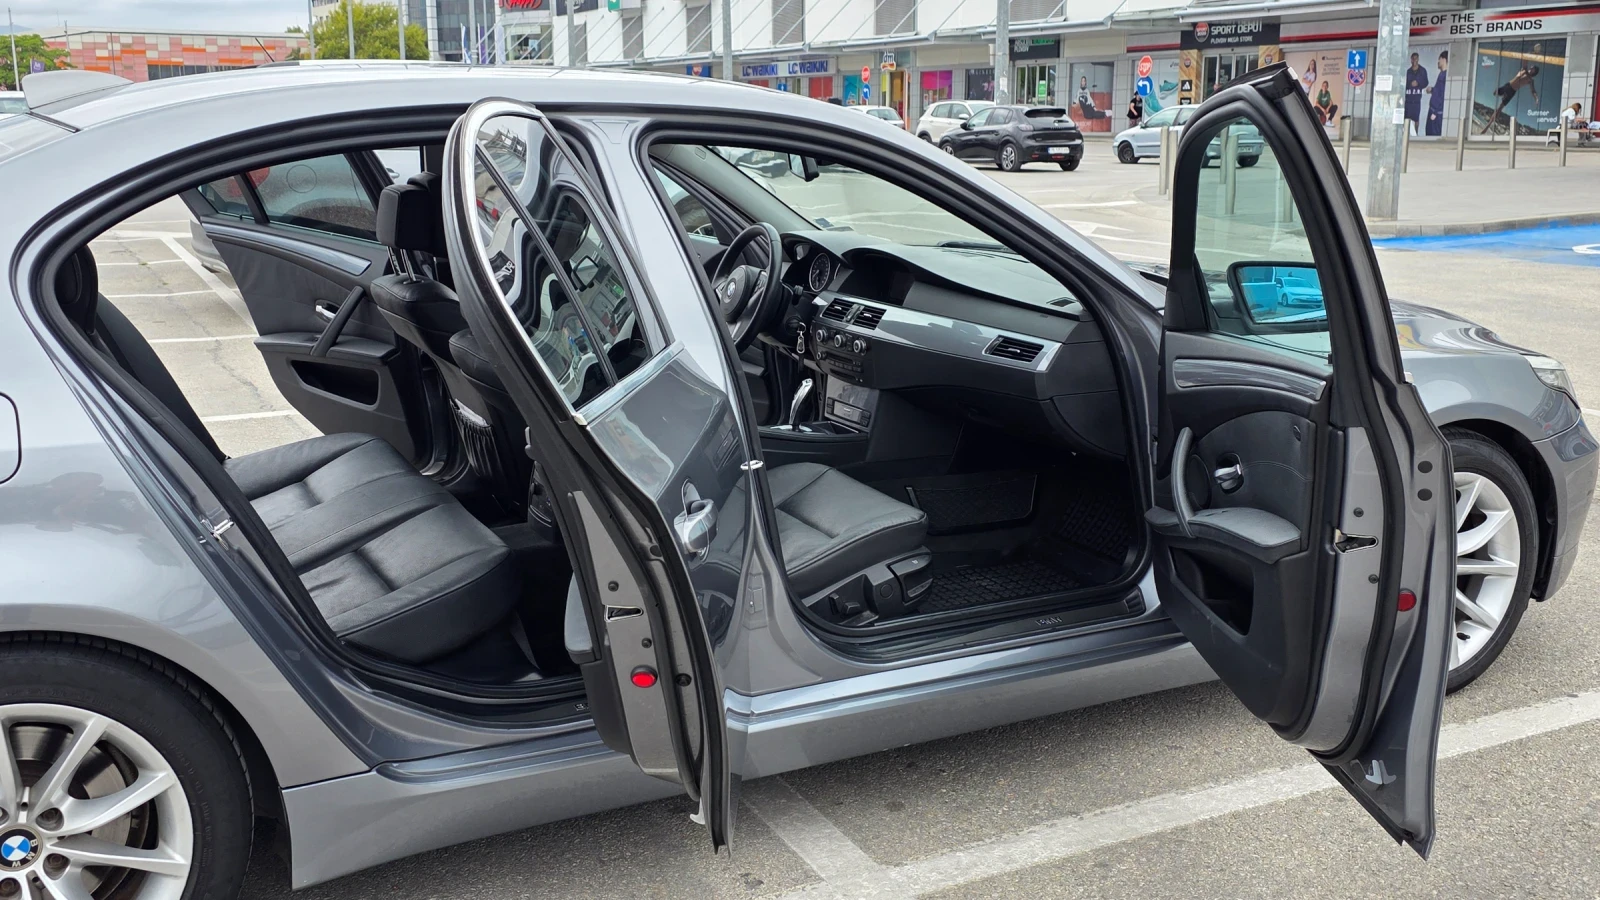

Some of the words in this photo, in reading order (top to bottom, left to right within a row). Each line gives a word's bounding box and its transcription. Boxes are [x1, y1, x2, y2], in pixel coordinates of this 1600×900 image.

[1410, 16, 1427, 26] ME
[1430, 15, 1447, 25] OF
[1451, 12, 1475, 23] THE
[1211, 25, 1236, 35] SPORT
[1450, 23, 1482, 35] BEST
[1486, 19, 1543, 33] BRANDS
[883, 51, 895, 64] dm
[742, 66, 751, 77] LC
[788, 63, 799, 74] LC
[1139, 62, 1152, 72] STOP
